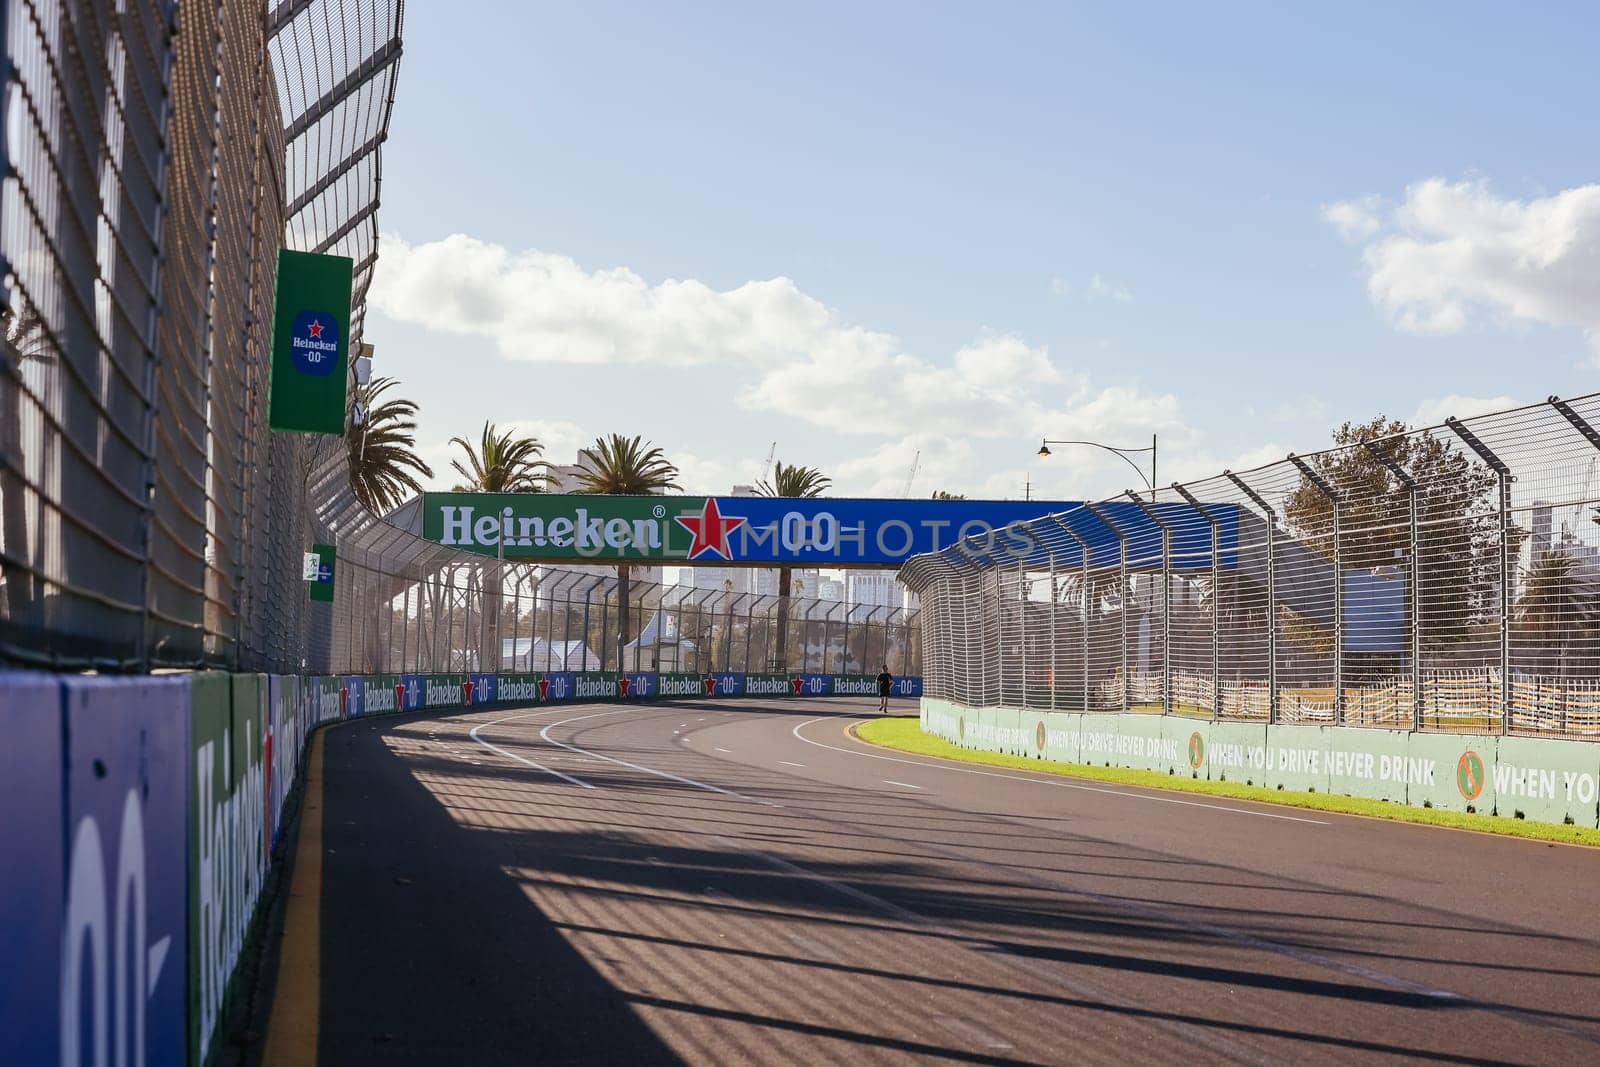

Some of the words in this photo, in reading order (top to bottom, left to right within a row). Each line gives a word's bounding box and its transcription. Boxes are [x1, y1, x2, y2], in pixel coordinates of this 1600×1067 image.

[293, 337, 337, 351] Heineken
[426, 679, 461, 706] Heineken
[497, 677, 536, 700] Heineken
[576, 676, 616, 697] Heineken
[660, 676, 702, 695] Heineken
[746, 676, 789, 694] Heineken
[834, 678, 877, 694] Heineken
[364, 681, 394, 713] Heineken
[1047, 729, 1069, 748] WHEN
[1071, 730, 1086, 750] YOU
[1089, 732, 1113, 752] DRIVE
[1117, 735, 1144, 756] NEVER
[1147, 738, 1179, 761] DRINK
[1208, 743, 1243, 767] WHEN
[1247, 744, 1274, 770] YOU
[1279, 748, 1319, 774] DRIVE
[1324, 751, 1374, 779] NEVER
[1380, 755, 1436, 786] DRINK
[1493, 765, 1555, 799] WHEN
[1563, 770, 1600, 804] YO
